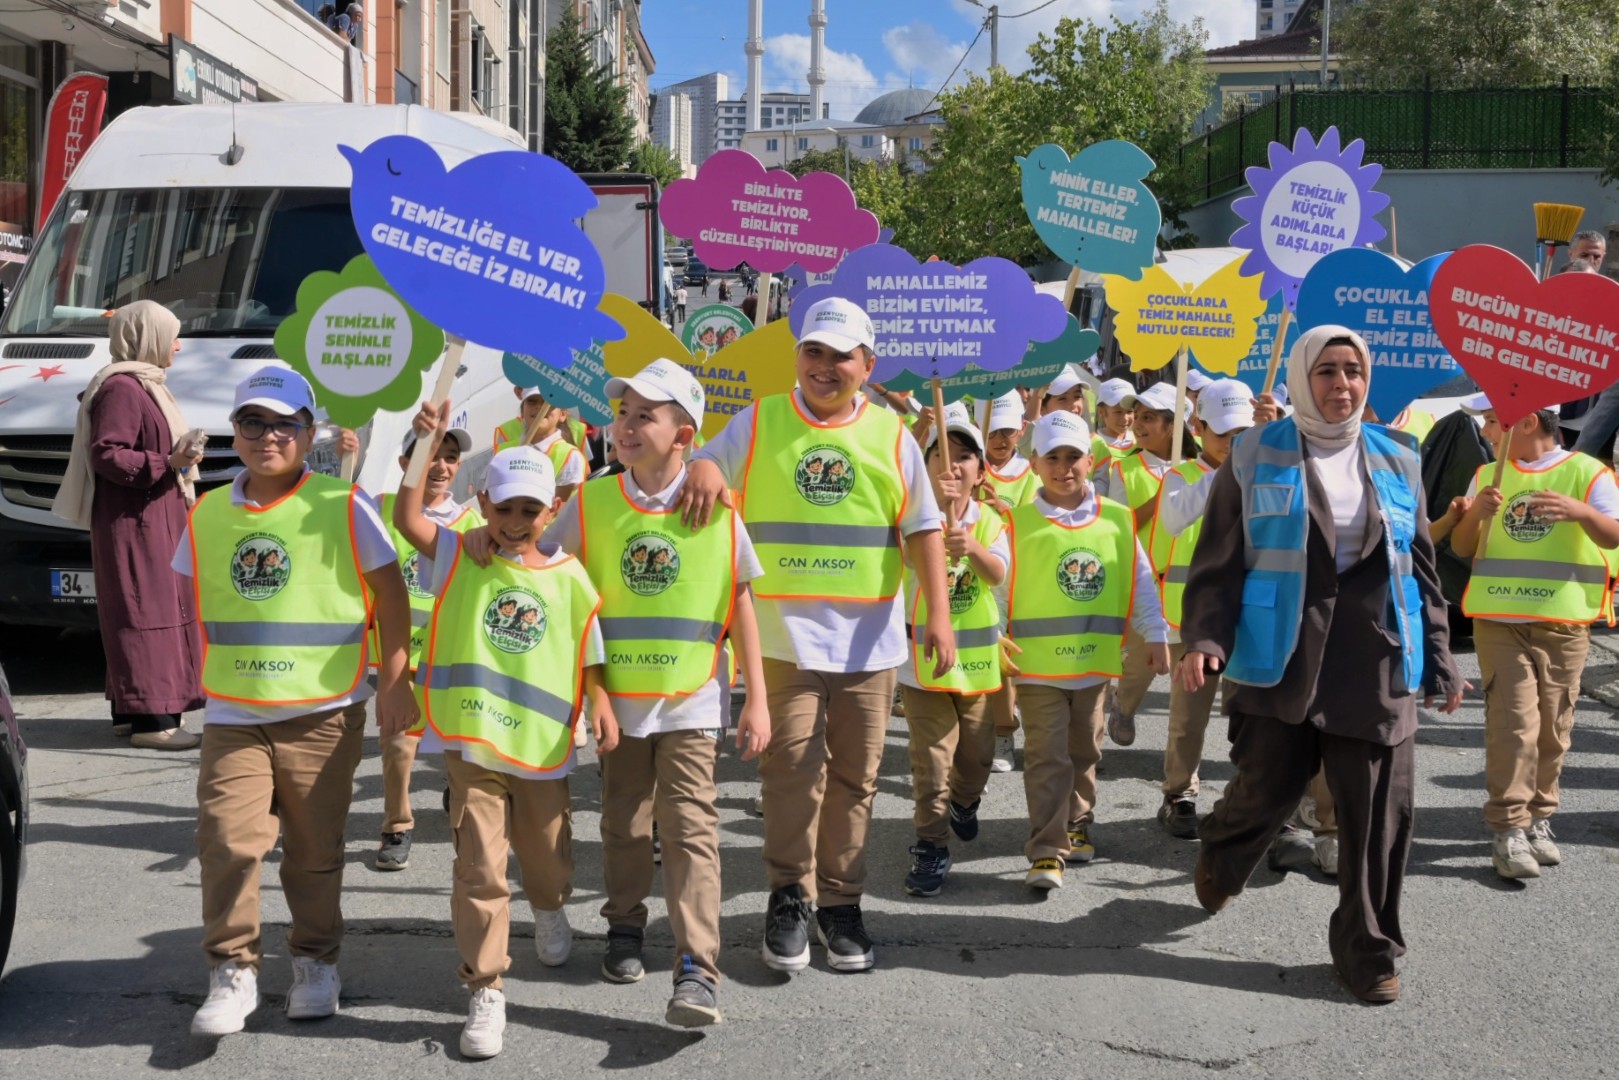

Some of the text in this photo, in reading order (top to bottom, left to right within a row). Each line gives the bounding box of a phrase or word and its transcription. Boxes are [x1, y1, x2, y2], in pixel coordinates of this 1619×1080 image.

[744, 181, 803, 201] BİRLİKTE
[1049, 169, 1140, 207] MİNİK ELLER,
[1290, 181, 1348, 206] TEMİZLİK
[731, 199, 812, 222] TEMİZLİYOR,
[1056, 190, 1128, 221] TERTEMİZ
[1291, 198, 1336, 220] KÜÇÜK
[740, 215, 799, 236] BİRLİKTE
[1036, 206, 1138, 245] MAHALLELER!
[1270, 214, 1346, 240] ADIMLARLA
[390, 195, 584, 282] TEMİZLİĞE EL VER,
[699, 227, 839, 259] GÜZELLEŞTİRİYORUZ!
[371, 222, 587, 311] GELECEĞE İZ BIRAK!
[866, 271, 988, 290] MAHALLEMİZ
[866, 294, 988, 315] BİZİM EVİMİZ,
[1147, 294, 1228, 308] ÇOCUKLARLA
[1334, 286, 1429, 307] ÇOCUKLA
[325, 312, 397, 330] TEMİZLİK
[873, 315, 997, 334] EMİZ TUTMAK
[1138, 307, 1235, 325] TEMİZ MAHALLE,
[1365, 308, 1432, 329] EL ELE,
[1451, 286, 1619, 351] BUGÜN TEMİZLİK,
[325, 331, 392, 348] SENİNLE
[1137, 323, 1235, 338] MUTLU GELECEK!
[1457, 311, 1609, 370] YARIN SAĞLIKLI
[873, 338, 982, 357] GÖREVİMİZ!
[321, 352, 393, 369] BAŞLAR!
[1461, 337, 1591, 389] BİR GELECEK!
[922, 364, 1060, 390] GZELLEŞTİRİYORUZ!
[802, 483, 844, 493] Temizlik
[1508, 524, 1546, 534] Temizlik
[779, 557, 856, 570] CAN AKSOY
[61, 572, 83, 595] 34
[238, 577, 280, 588] Temizlik
[627, 573, 668, 584] Temizlik
[1487, 586, 1511, 595] CAN
[1515, 587, 1556, 599] AKSOY
[489, 624, 533, 645] Temizlik
[611, 653, 678, 665] CAN AKSOY
[1055, 646, 1075, 656] CAN
[248, 660, 295, 672] AKSOY
[461, 698, 484, 711] CAN
